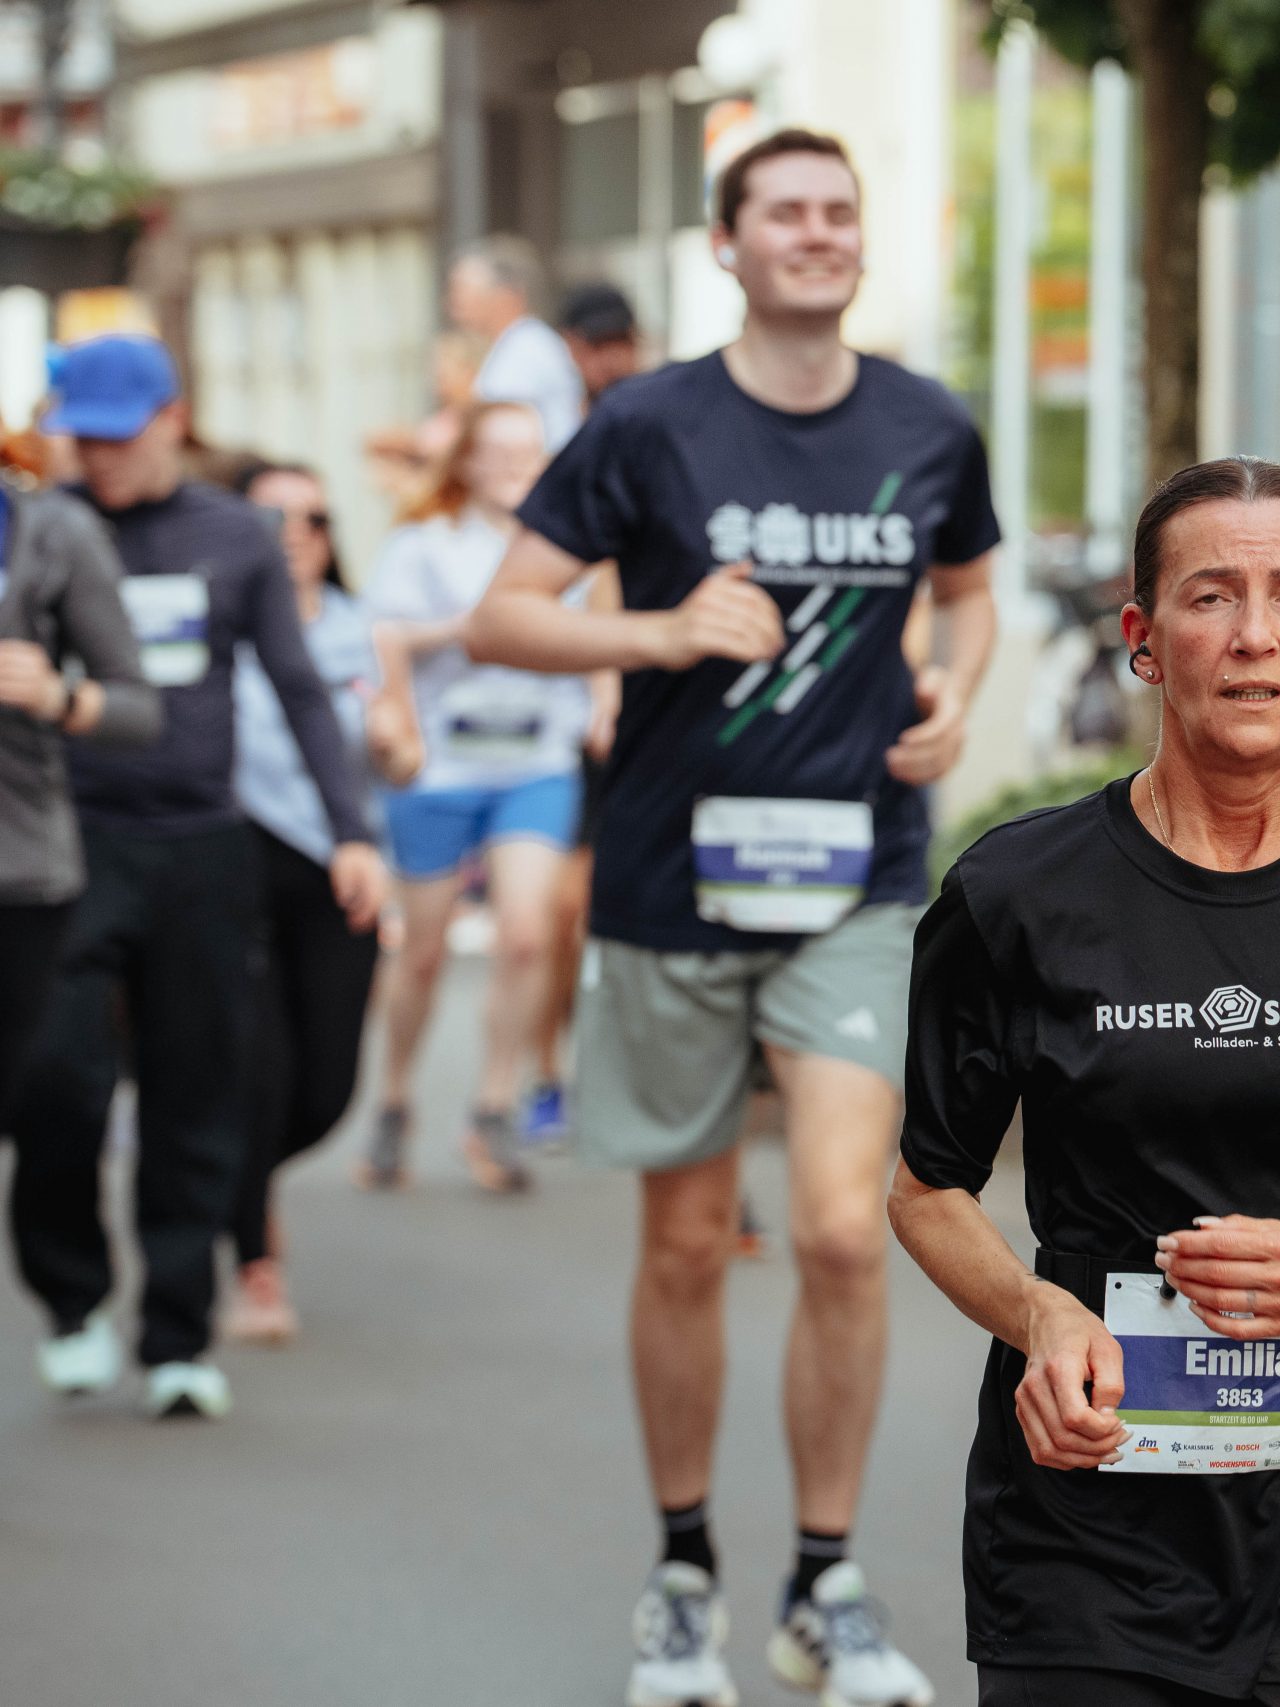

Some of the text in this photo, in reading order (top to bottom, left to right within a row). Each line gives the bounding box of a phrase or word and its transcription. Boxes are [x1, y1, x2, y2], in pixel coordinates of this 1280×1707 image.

[813, 512, 915, 566] UKS
[1096, 1003, 1195, 1032] RUSER
[1194, 1036, 1259, 1049] Rollladen-
[1263, 1036, 1273, 1047] &
[1216, 1388, 1263, 1407] 3853
[1209, 1415, 1239, 1424] STARTZEIT
[1256, 1415, 1269, 1424] UHR
[1138, 1437, 1157, 1447] dm
[1209, 1460, 1257, 1468] WOCHENSPIEGEL
